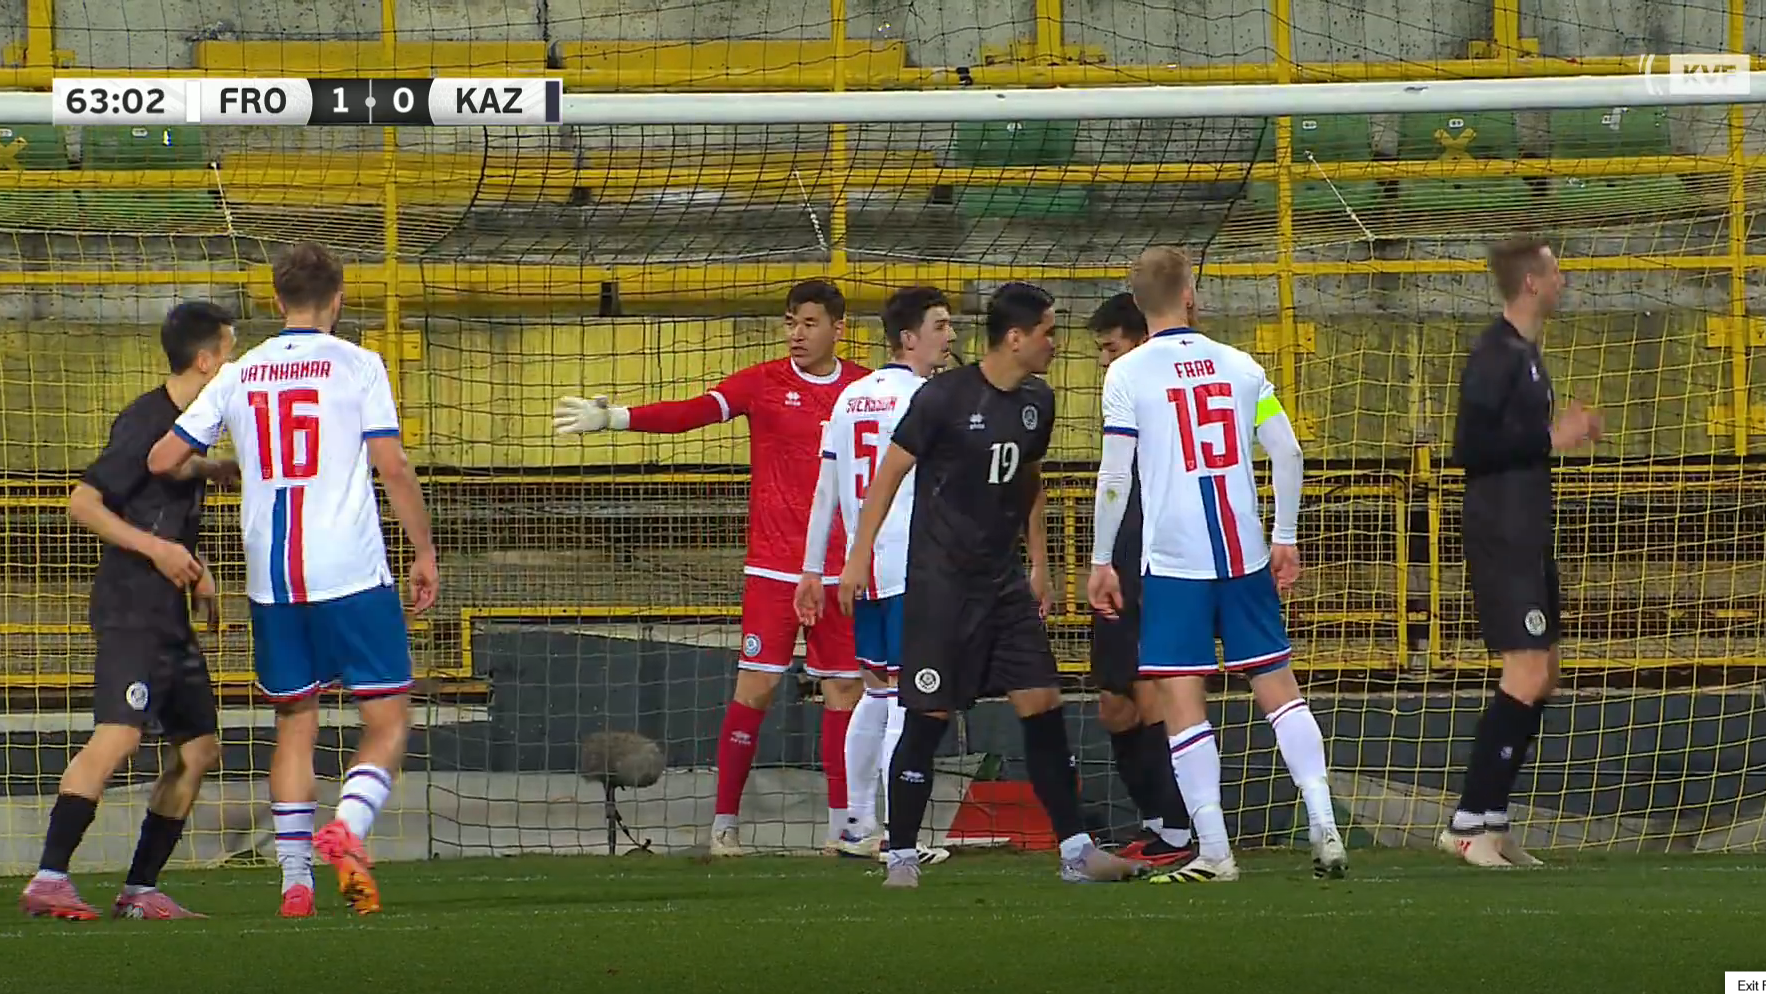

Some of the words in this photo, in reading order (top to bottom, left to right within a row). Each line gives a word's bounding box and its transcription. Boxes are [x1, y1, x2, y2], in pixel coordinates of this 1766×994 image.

[247, 388, 319, 480] 16
[854, 420, 880, 499] 5
[987, 442, 1020, 484] 19
[1166, 382, 1238, 472] 15
